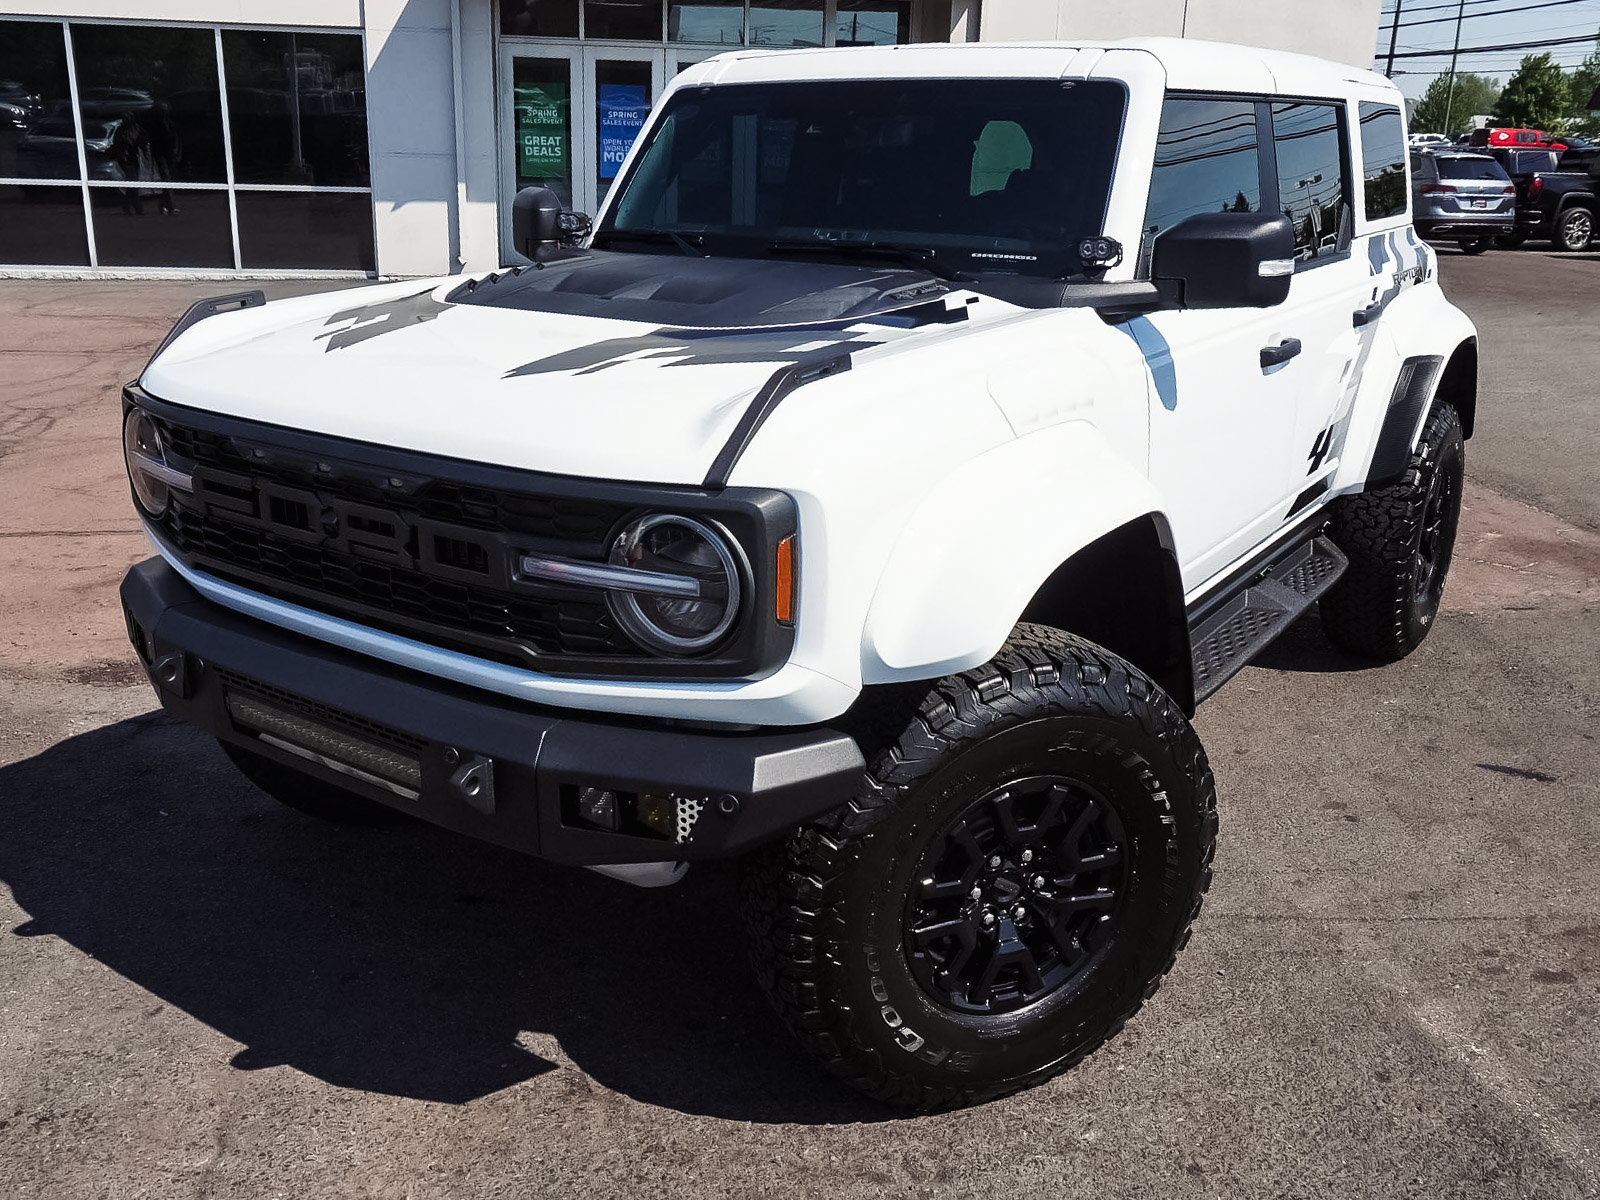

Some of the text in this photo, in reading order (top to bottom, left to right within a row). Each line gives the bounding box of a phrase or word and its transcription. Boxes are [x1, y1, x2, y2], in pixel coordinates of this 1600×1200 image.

[527, 109, 558, 117] SPRING
[525, 136, 562, 146] GREAT
[525, 146, 561, 156] DEALS
[604, 152, 627, 162] MO
[971, 252, 1038, 261] BRONCO
[1392, 265, 1423, 287] RAPTOR
[190, 464, 507, 583] FORD
